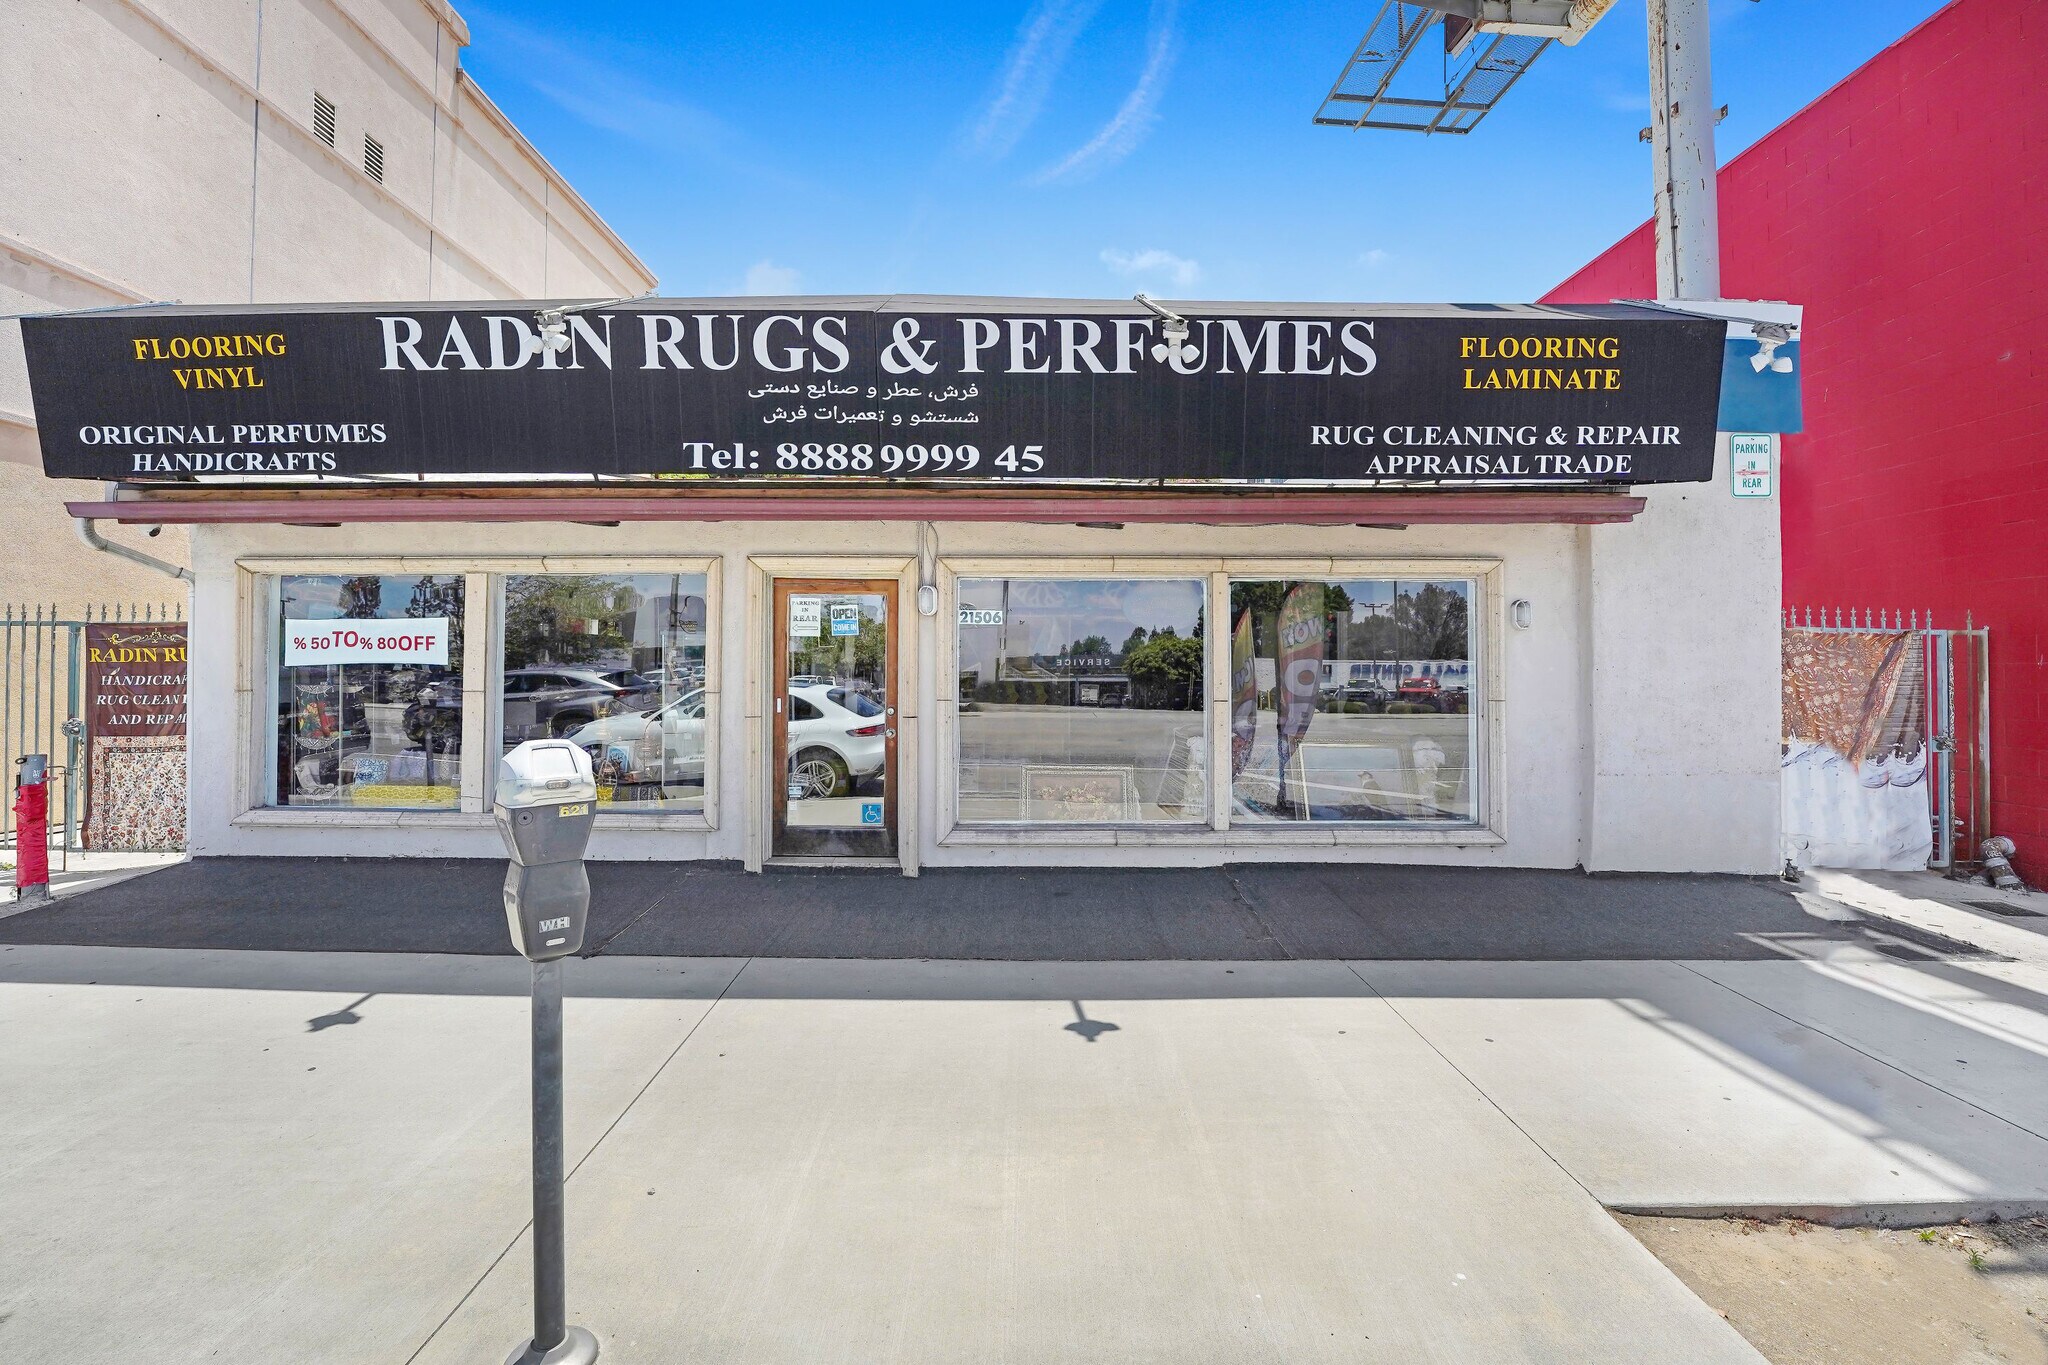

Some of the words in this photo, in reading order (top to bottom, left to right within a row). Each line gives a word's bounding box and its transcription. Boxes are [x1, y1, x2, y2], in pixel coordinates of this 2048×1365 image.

[134, 333, 285, 361] FLOORING
[637, 315, 850, 373] RUGS
[880, 317, 940, 375] &
[956, 316, 1378, 376] PERFUMES
[1460, 337, 1619, 359] FLOORING
[173, 365, 264, 390] VINYL
[1463, 368, 1621, 391] LAMINATE
[79, 425, 225, 446] ORIGINAL
[232, 423, 387, 444] PERFUMES
[1311, 425, 1376, 446] RUG
[1383, 425, 1538, 446] CLEANING
[1546, 425, 1568, 446] &
[1576, 425, 1682, 446] REPAIR
[683, 442, 760, 471] Tel:
[994, 444, 1044, 473] 45
[1735, 443, 1768, 454] PARKING
[132, 452, 337, 473] HANDICRAFTS
[1365, 454, 1530, 474] APPRAISAL
[1535, 454, 1632, 474] TRADE
[1748, 460, 1756, 470] IN
[1742, 478, 1762, 488] REAR
[833, 623, 850, 632] COME
[850, 623, 857, 631] IN
[959, 611, 1001, 624] 21506
[89, 647, 158, 663] RADIN
[97, 695, 129, 705] RUG
[108, 715, 141, 725] AND
[559, 804, 588, 817] 621
